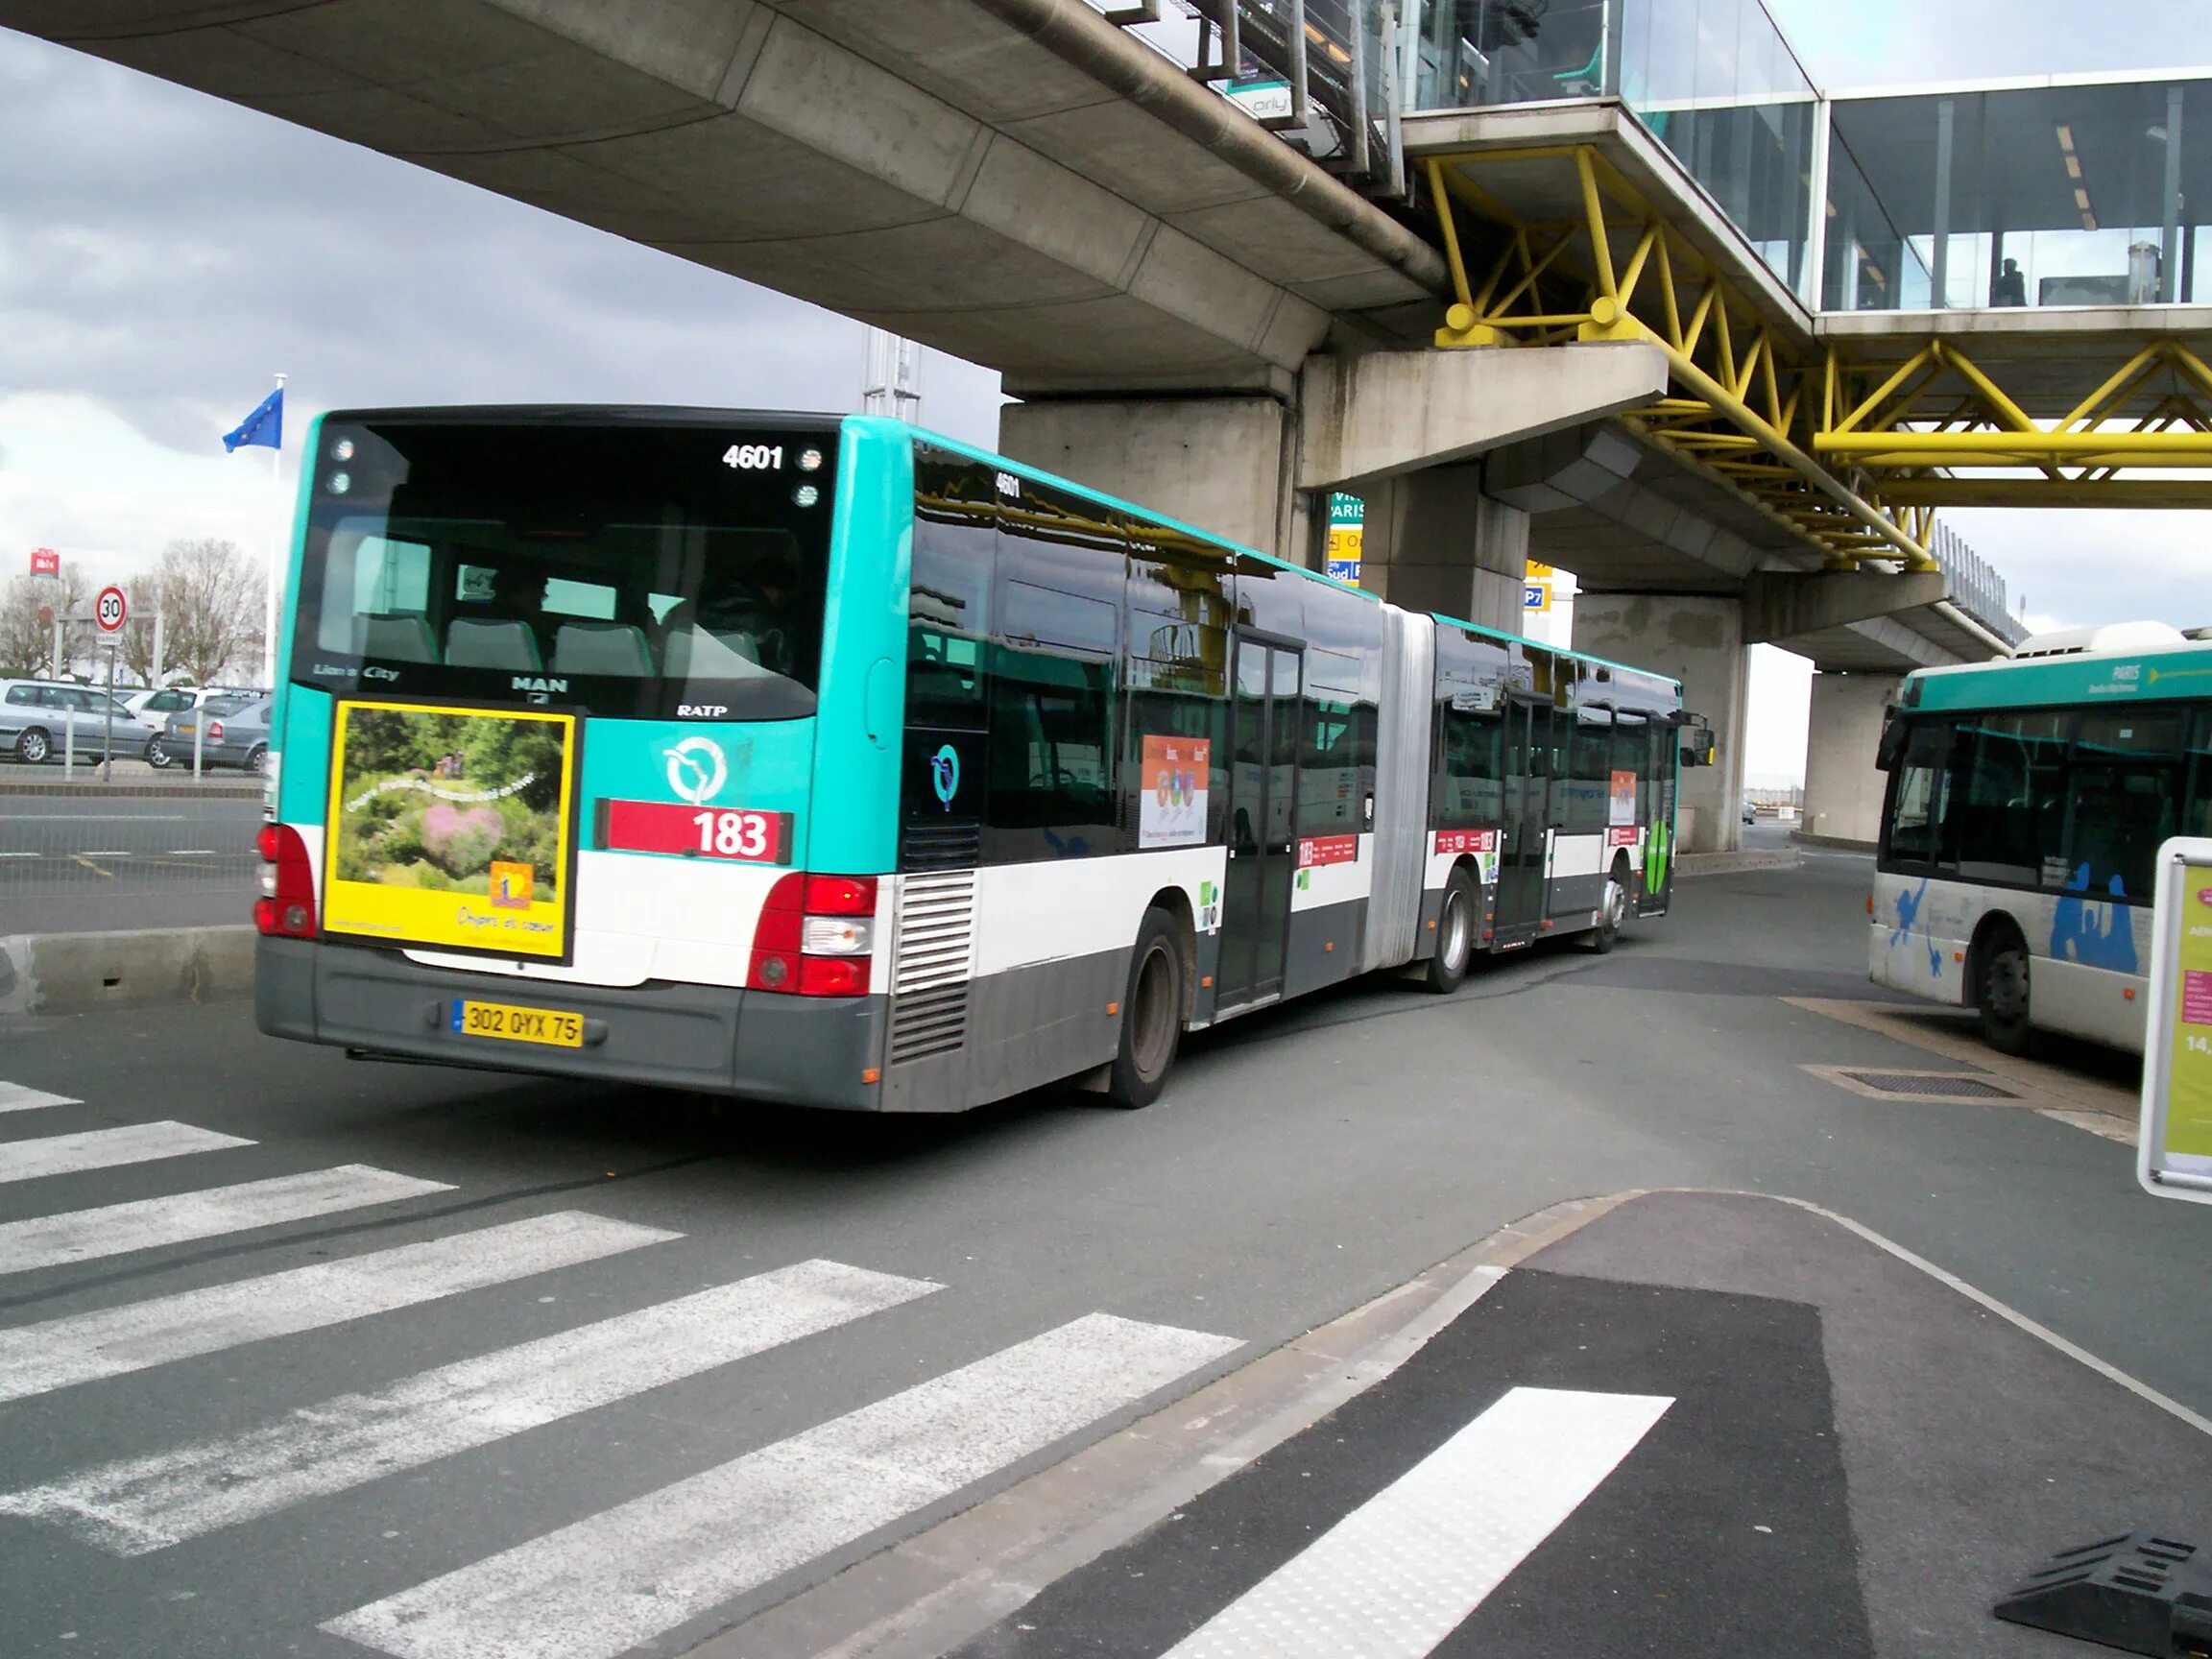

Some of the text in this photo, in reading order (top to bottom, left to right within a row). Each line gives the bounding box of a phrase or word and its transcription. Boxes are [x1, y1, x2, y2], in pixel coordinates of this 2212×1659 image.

[1254, 97, 1287, 111] orly
[723, 445, 782, 469] 4601
[102, 599, 120, 618] 30
[363, 666, 399, 682] City
[511, 677, 568, 692] MAN
[677, 705, 728, 717] RATP
[693, 811, 767, 856] 183
[469, 1007, 504, 1032] 302
[554, 1017, 577, 1041] 75
